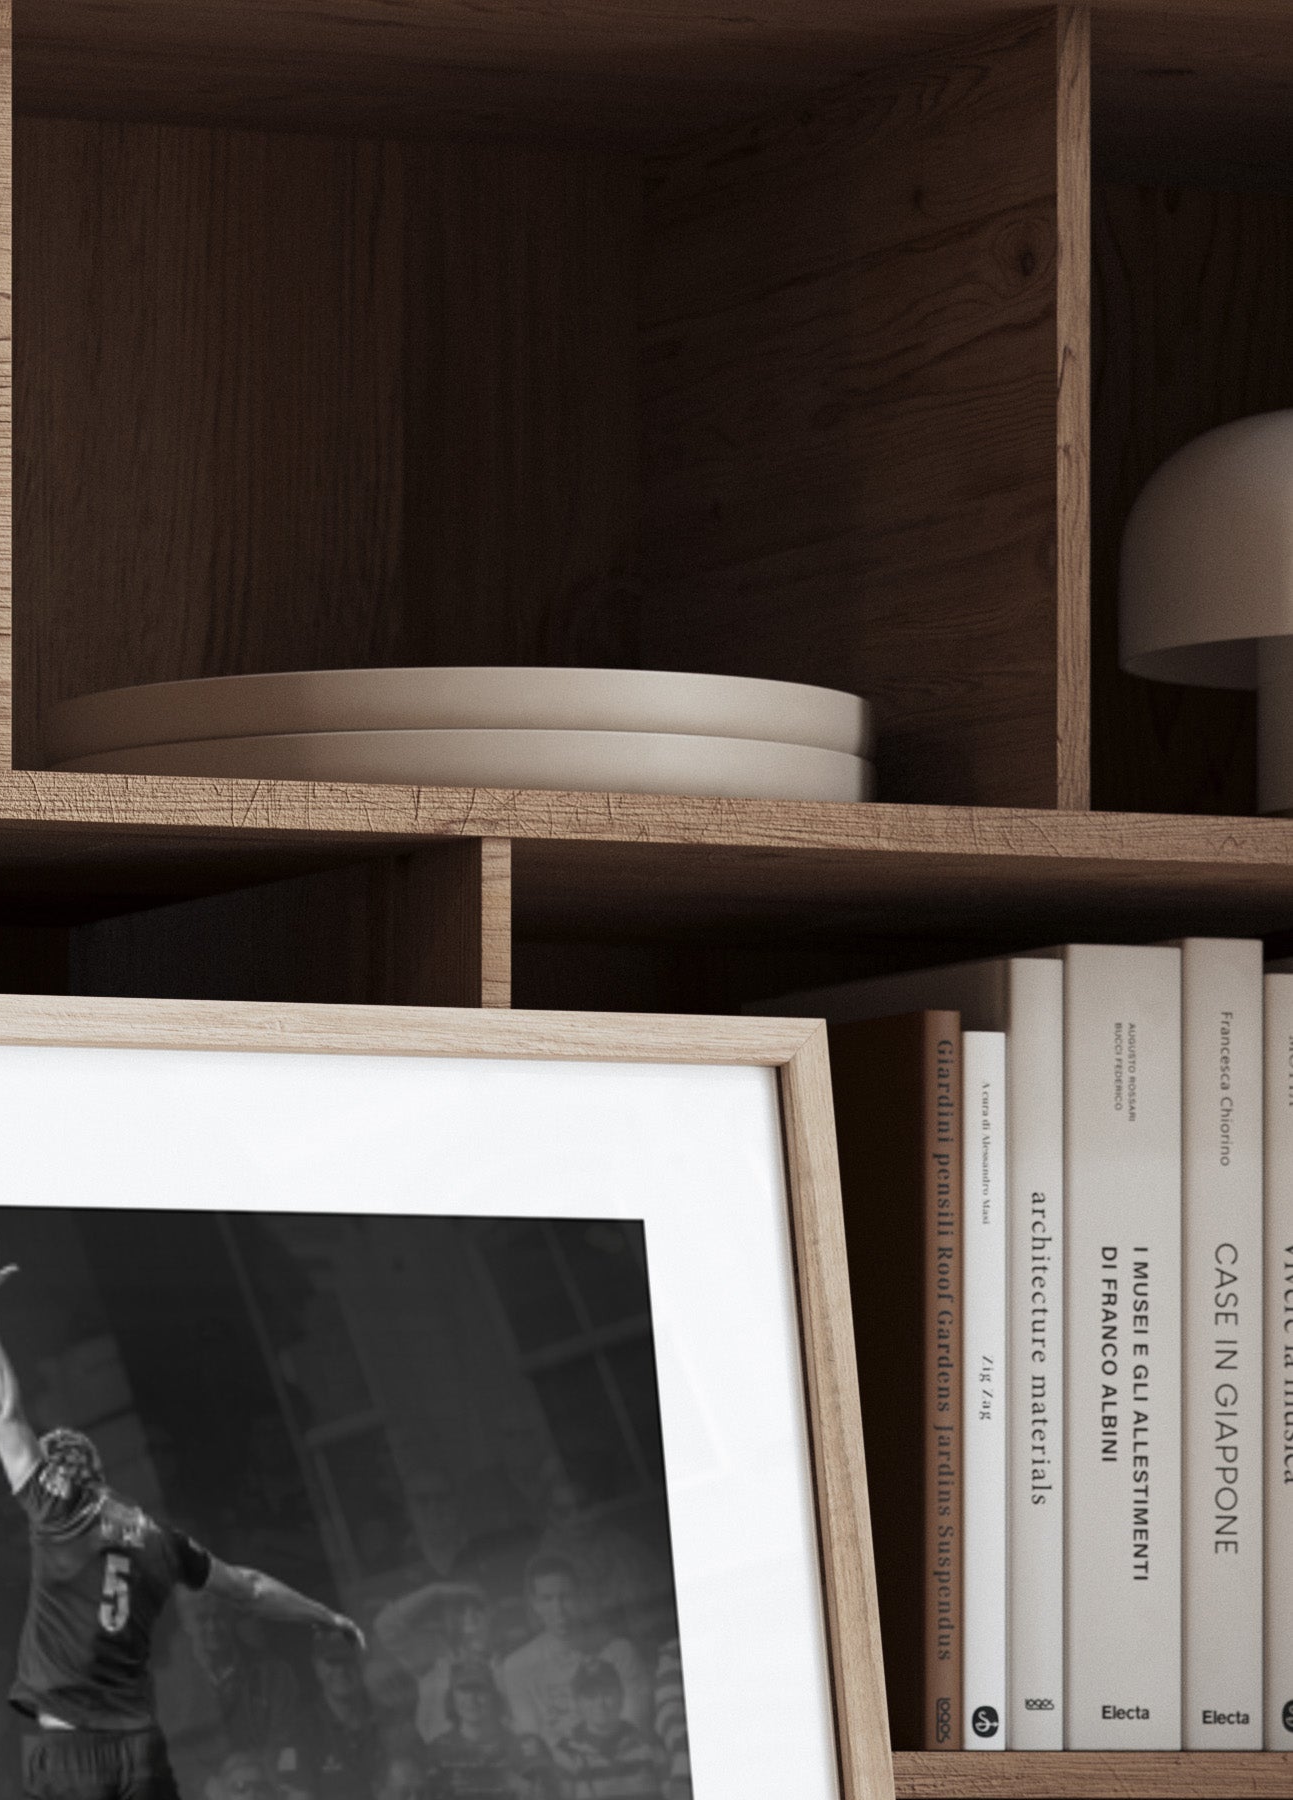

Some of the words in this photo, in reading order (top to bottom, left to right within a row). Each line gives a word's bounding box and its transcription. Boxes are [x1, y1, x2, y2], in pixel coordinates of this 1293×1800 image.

[1114, 1022, 1123, 1055] BUCCI
[1128, 1022, 1136, 1073] AUGUSTO
[1220, 1011, 1233, 1091] Francesca
[937, 1039, 954, 1143] Giardini
[1114, 1057, 1123, 1111] FEDERICO
[1220, 1097, 1234, 1167] Chiorino
[933, 1153, 954, 1237] pensili
[937, 1246, 954, 1303] Roof
[1031, 1191, 1053, 1363] architecture
[1101, 1246, 1118, 1269] DI
[1214, 1242, 1239, 1326] CASE
[1101, 1278, 1118, 1376] FRANCO
[1133, 1261, 1149, 1334] MUSEI
[936, 1310, 954, 1412] Gardens
[979, 1355, 993, 1383] Zig
[1133, 1343, 1149, 1356] E
[1133, 1364, 1149, 1402] GLI
[1214, 1339, 1239, 1370] IN
[979, 1388, 993, 1421] Zag
[1031, 1374, 1053, 1506] materials
[1101, 1384, 1118, 1462] ALBINI
[935, 1422, 954, 1517] Jardins
[1133, 1410, 1149, 1581] ALLESTIMENTI
[1214, 1383, 1239, 1555] GIAPPONE
[98, 1553, 131, 1632] 5
[933, 1525, 954, 1661] Suspendus
[1101, 1705, 1151, 1721] Electa
[1201, 1710, 1250, 1725] Electa
